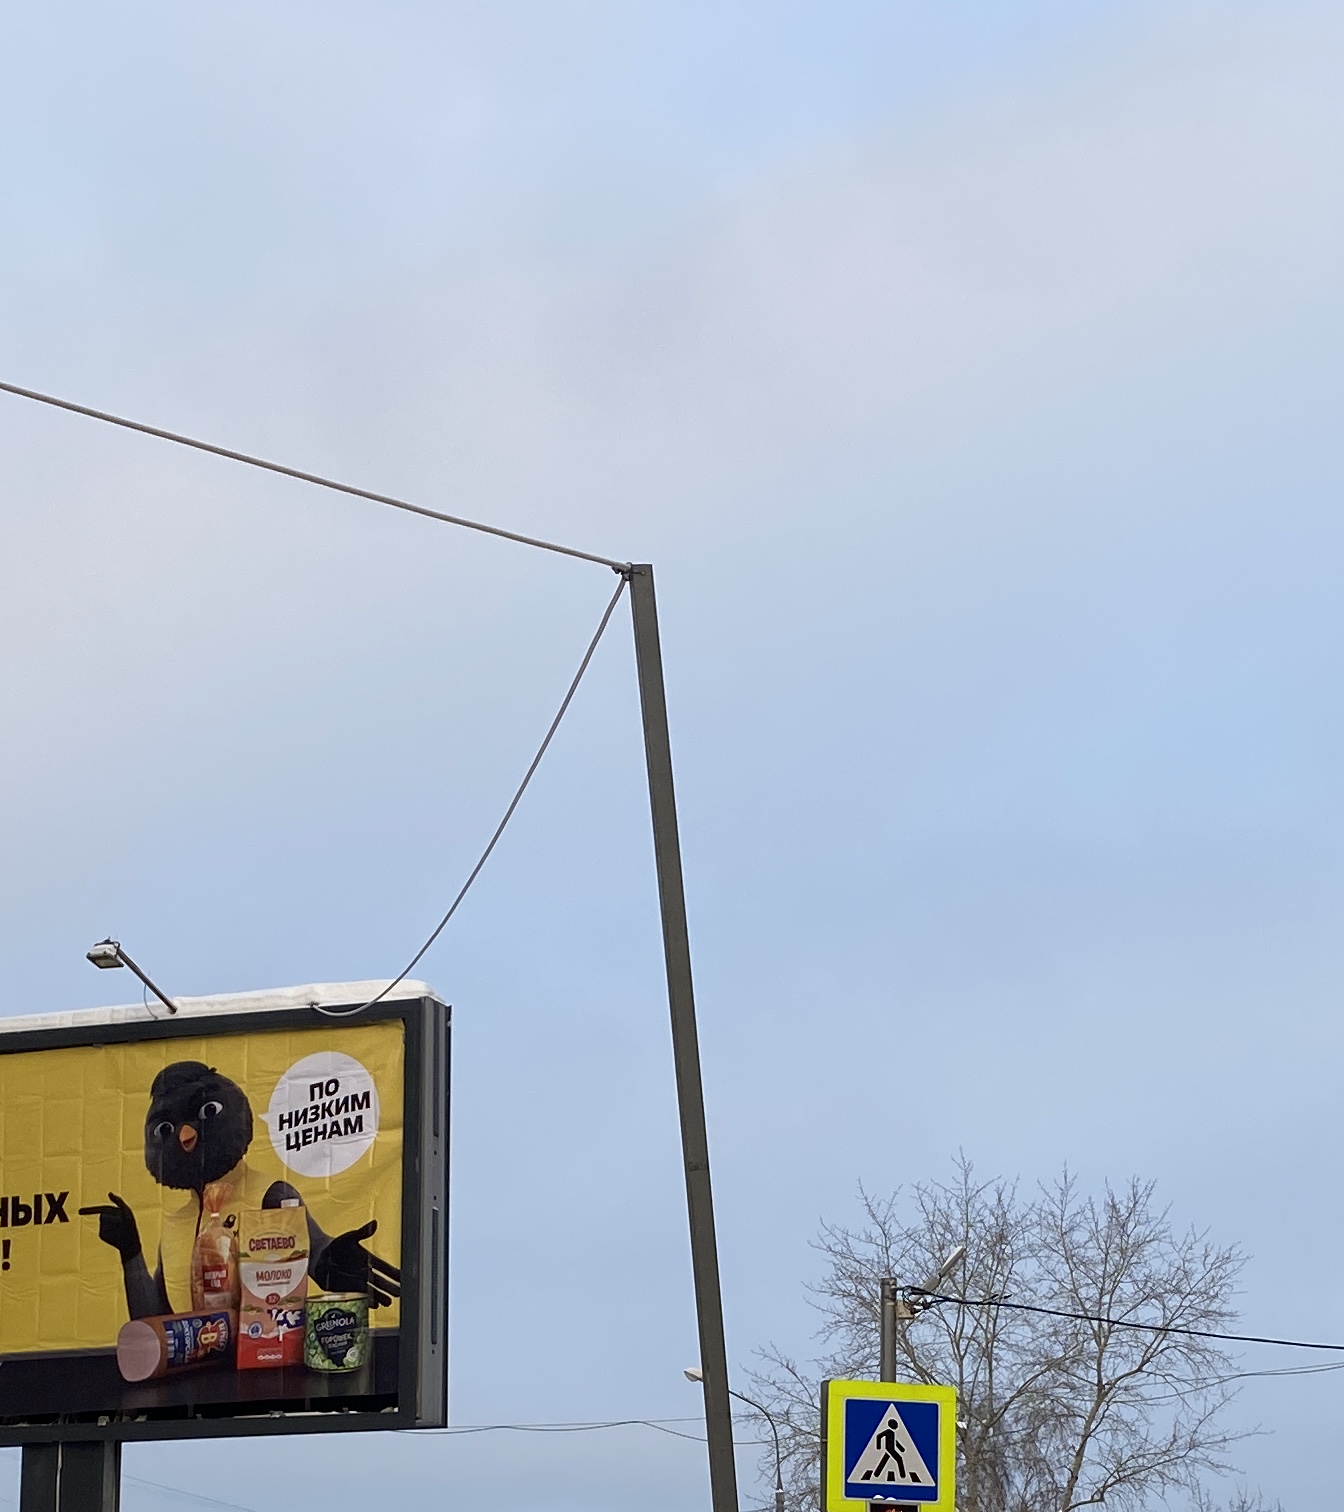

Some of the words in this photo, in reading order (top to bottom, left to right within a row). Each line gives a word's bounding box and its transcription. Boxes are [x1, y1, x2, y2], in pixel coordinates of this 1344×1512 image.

[309, 1078, 340, 1102] ПО
[278, 1091, 371, 1131] НИЗКИМ
[286, 1115, 363, 1152] ЦЕНАМ
[248, 1237, 296, 1251] СВЕТАЕВО
[256, 1268, 292, 1282] МОЛОКО
[315, 1316, 355, 1332] GREENOLA
